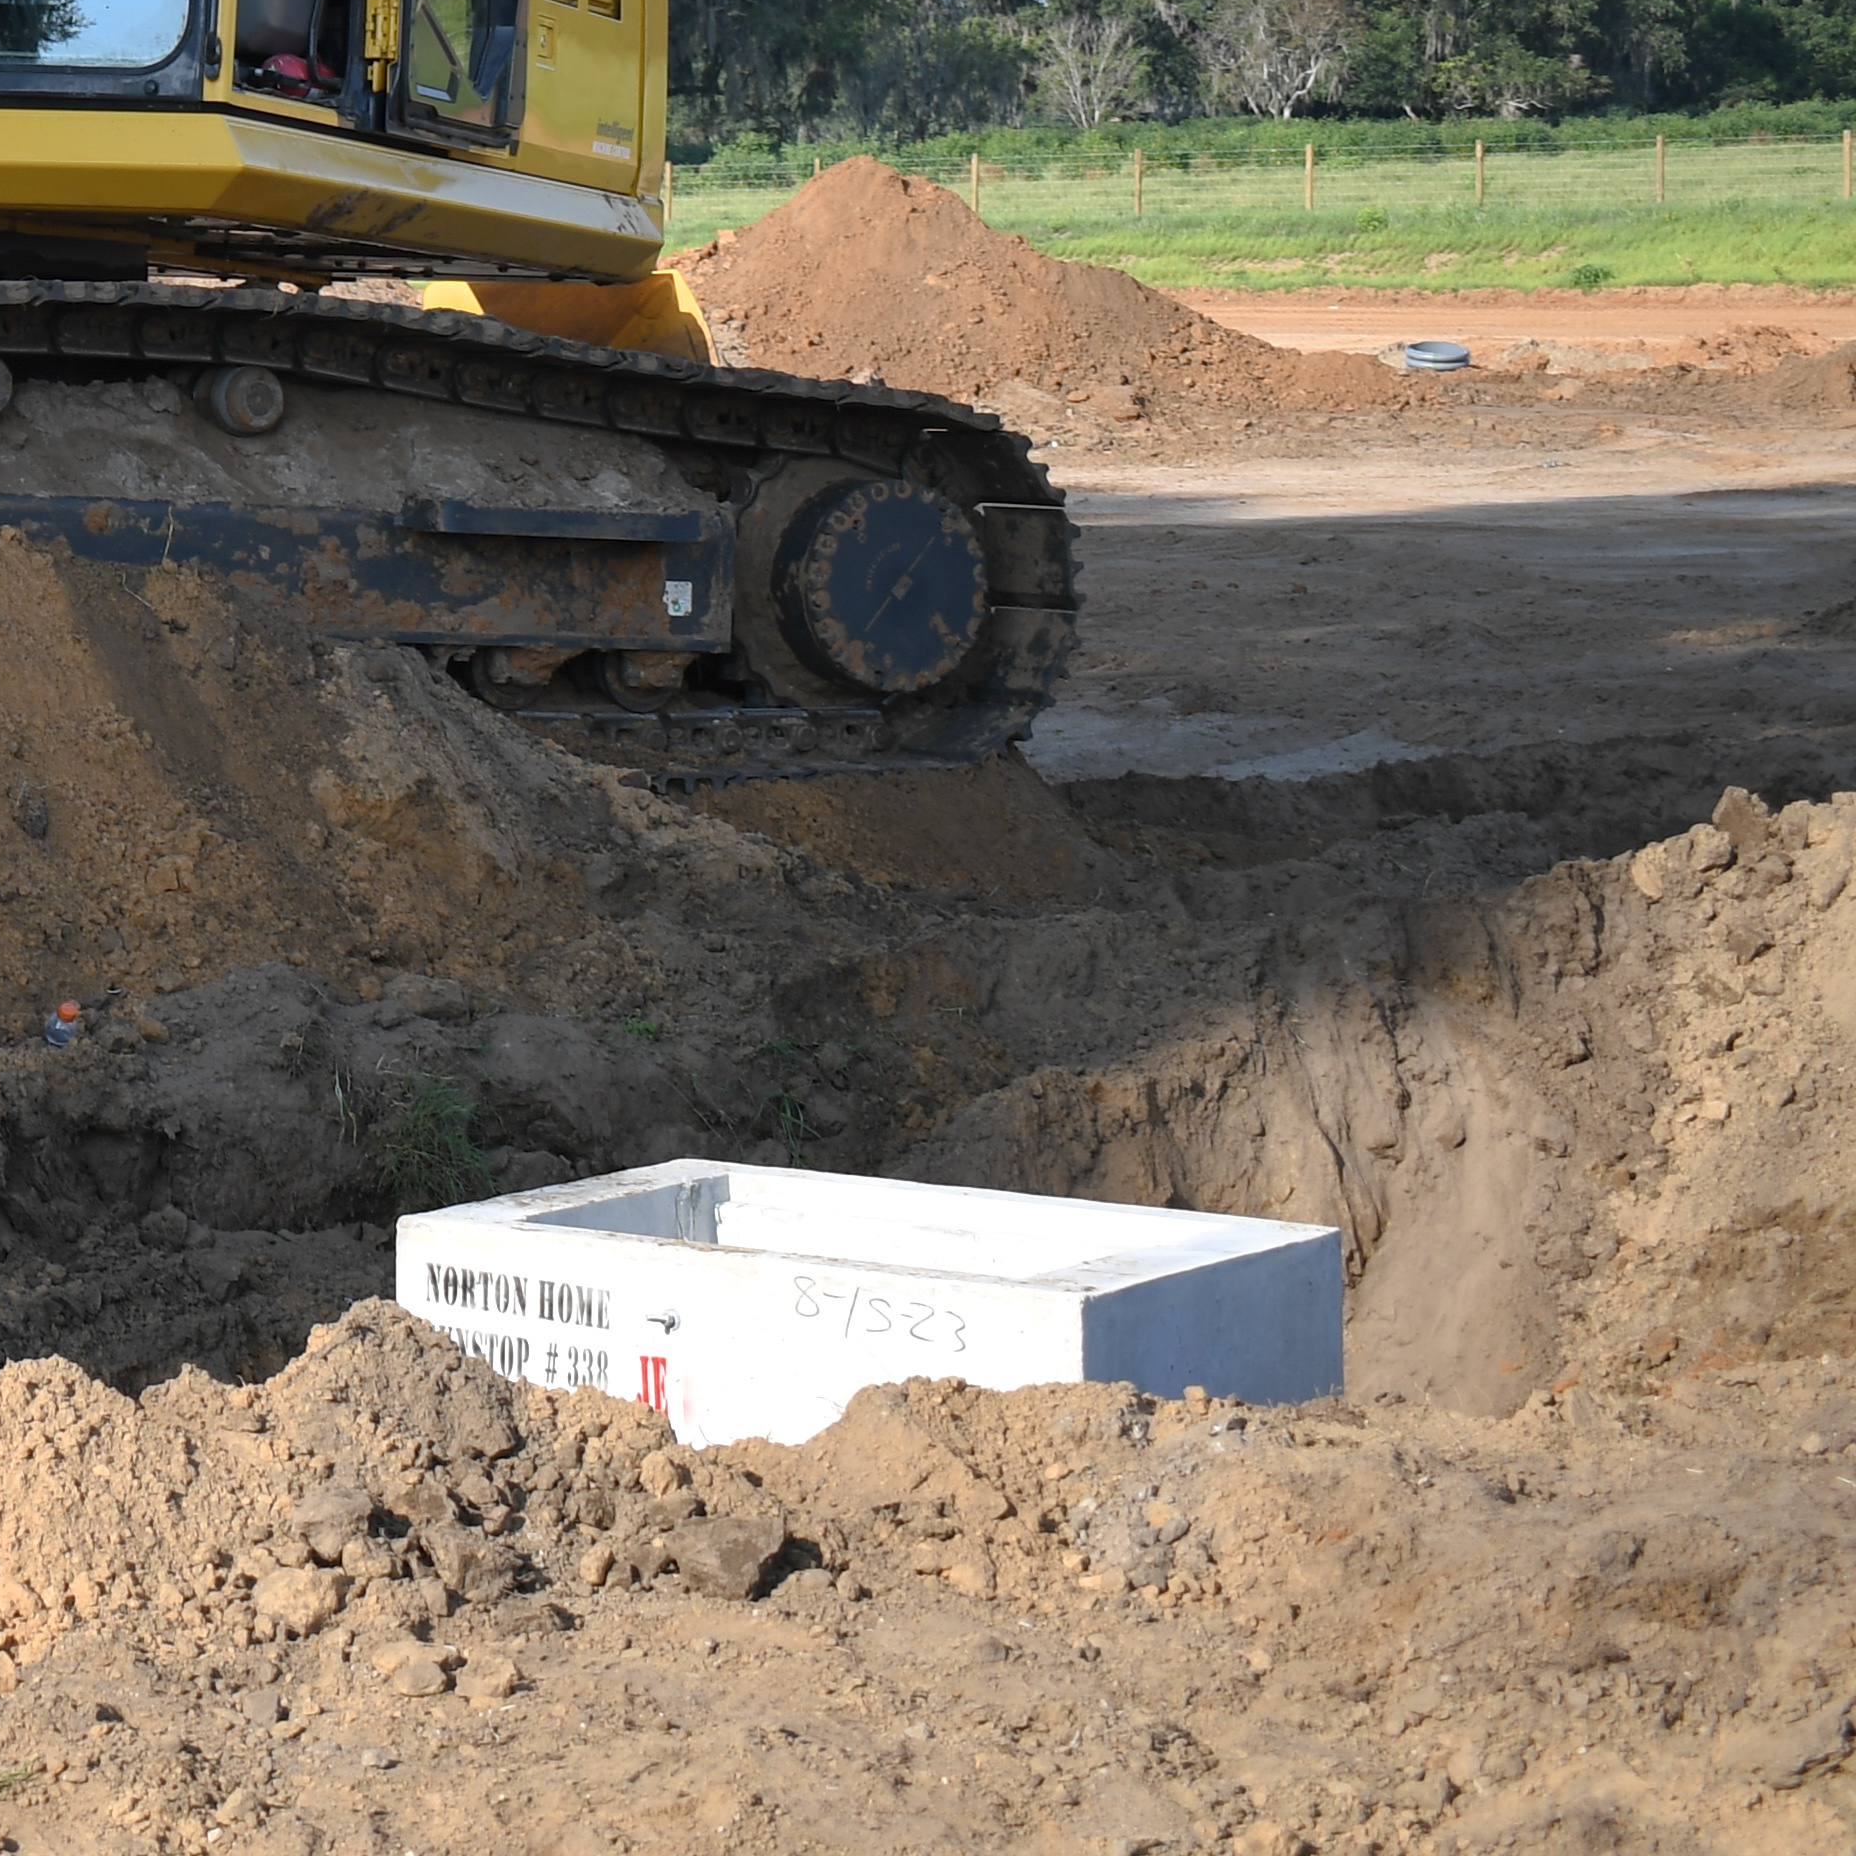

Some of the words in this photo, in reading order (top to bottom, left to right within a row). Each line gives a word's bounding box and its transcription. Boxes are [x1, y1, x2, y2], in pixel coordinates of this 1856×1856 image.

[426, 1262, 528, 1316] NORTON
[538, 1279, 610, 1330] HOME
[793, 1275, 966, 1352] 8-15-23
[567, 1345, 609, 1392] 338
